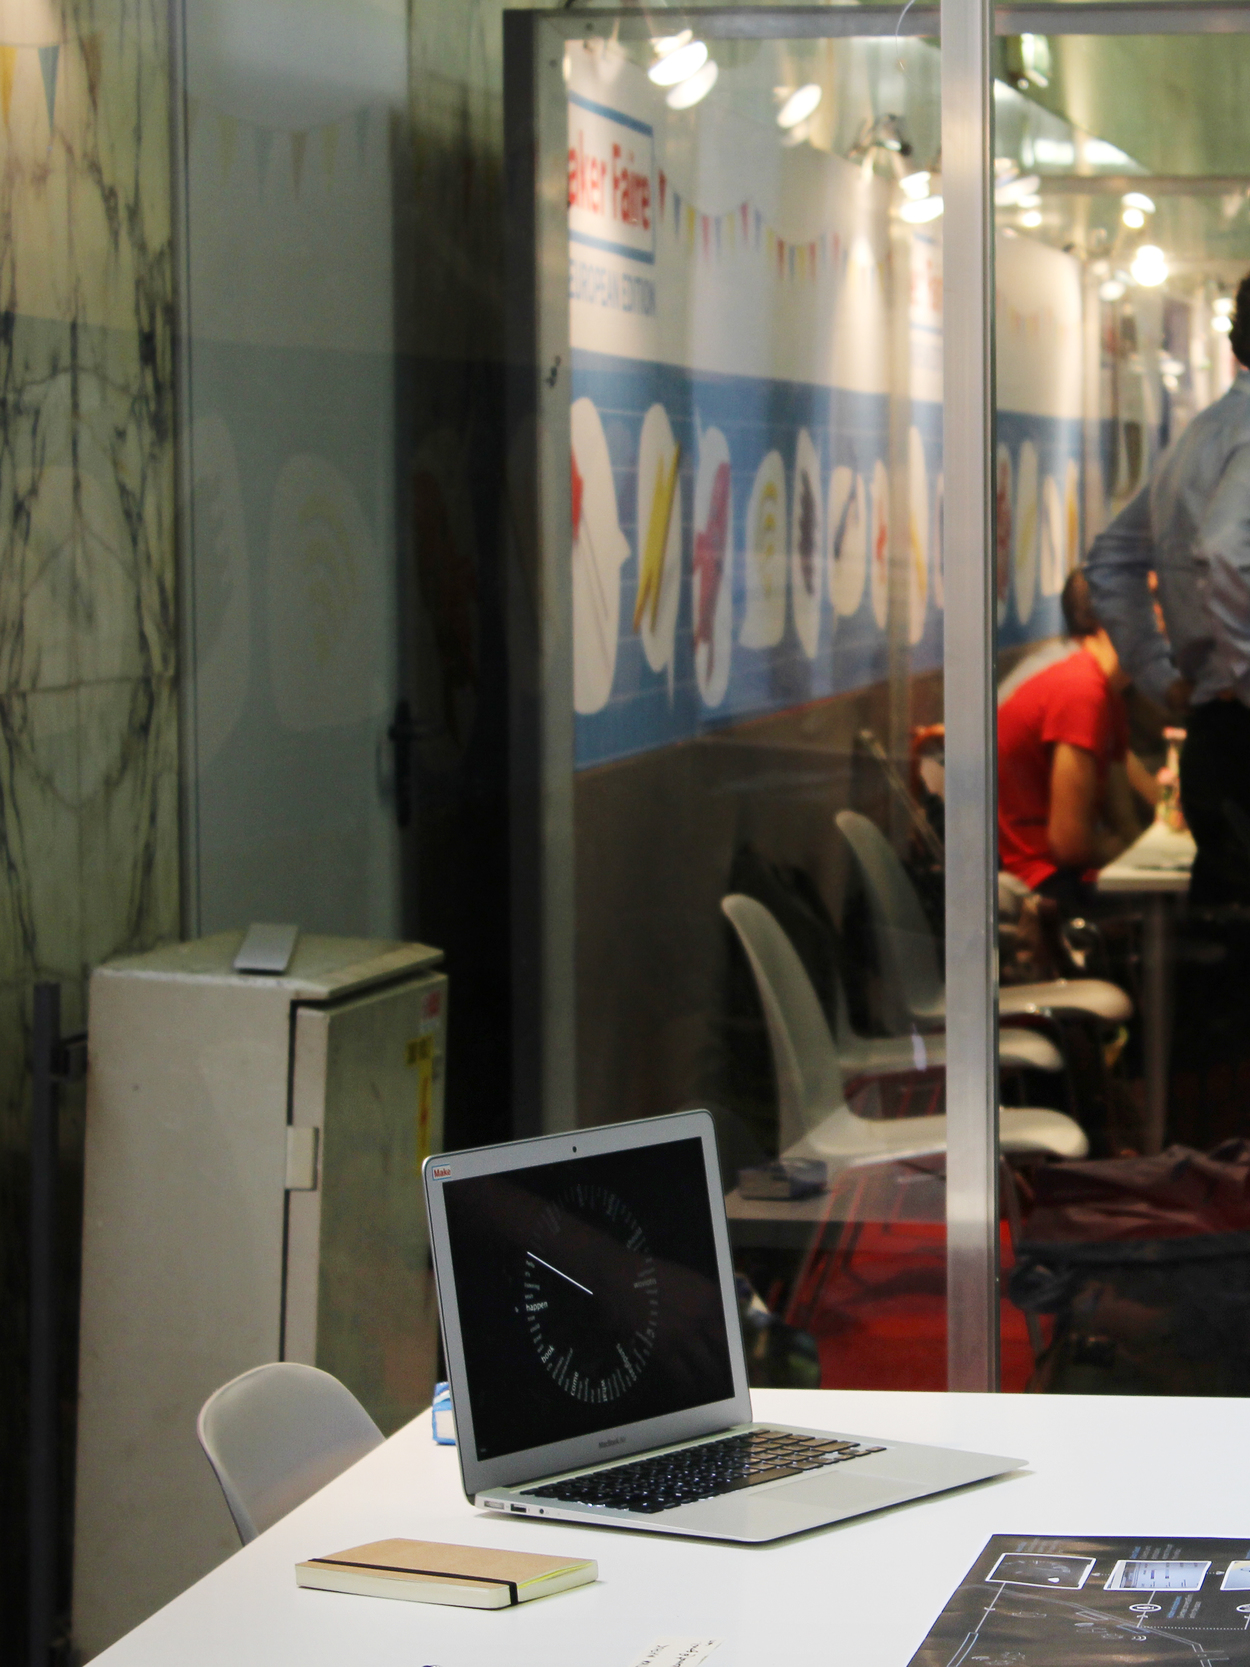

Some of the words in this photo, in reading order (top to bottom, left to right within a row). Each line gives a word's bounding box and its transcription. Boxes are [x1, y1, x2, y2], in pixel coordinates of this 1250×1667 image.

[568, 130, 606, 216] aker
[612, 143, 651, 230] Faire
[525, 1300, 549, 1312] happen
[540, 1344, 555, 1364] book
[570, 1370, 580, 1397] come
